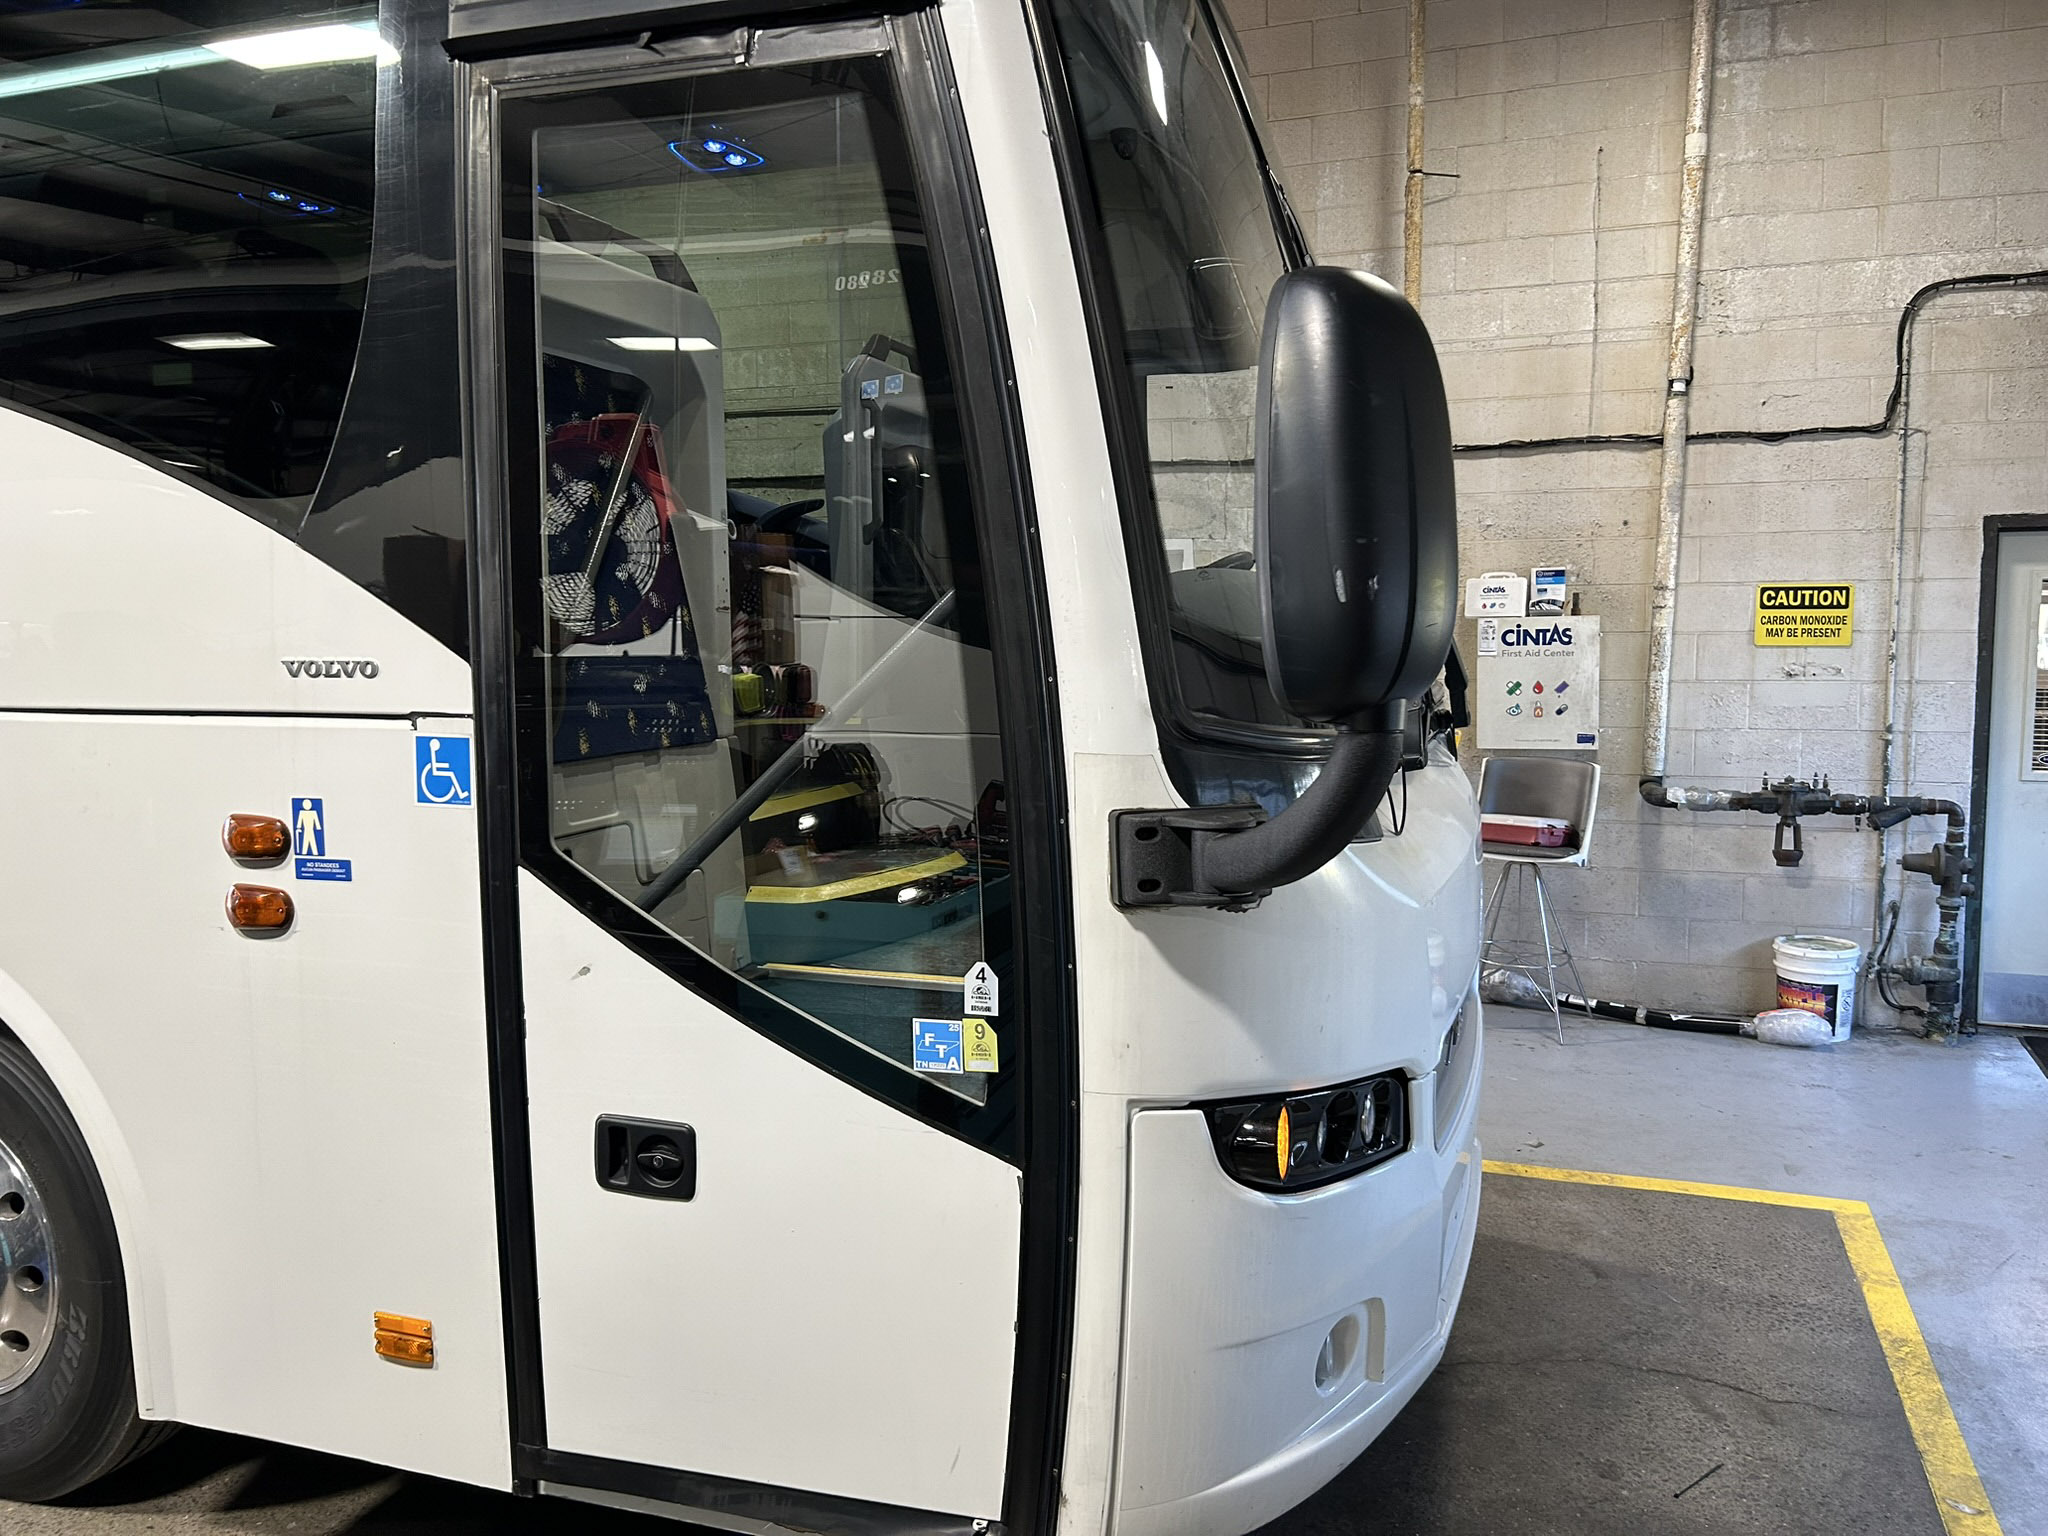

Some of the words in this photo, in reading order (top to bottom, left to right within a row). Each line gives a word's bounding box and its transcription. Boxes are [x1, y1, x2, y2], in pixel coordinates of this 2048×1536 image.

[1762, 589, 1847, 606] CAUTION
[1760, 615, 1797, 625] CARBON
[1799, 615, 1848, 625] MONOXIDE
[1501, 623, 1573, 646] CiNTAS
[1765, 628, 1784, 638] MAY
[1786, 628, 1798, 638] BE
[1800, 628, 1842, 638] PRESENT
[1501, 649, 1522, 657] First
[1524, 649, 1540, 657] Aid
[1543, 649, 1575, 657] Center
[281, 660, 379, 679] VOLVO
[975, 967, 987, 984] 4
[948, 1023, 960, 1032] 25
[974, 1023, 986, 1040] 9
[915, 1061, 929, 1069] TN
